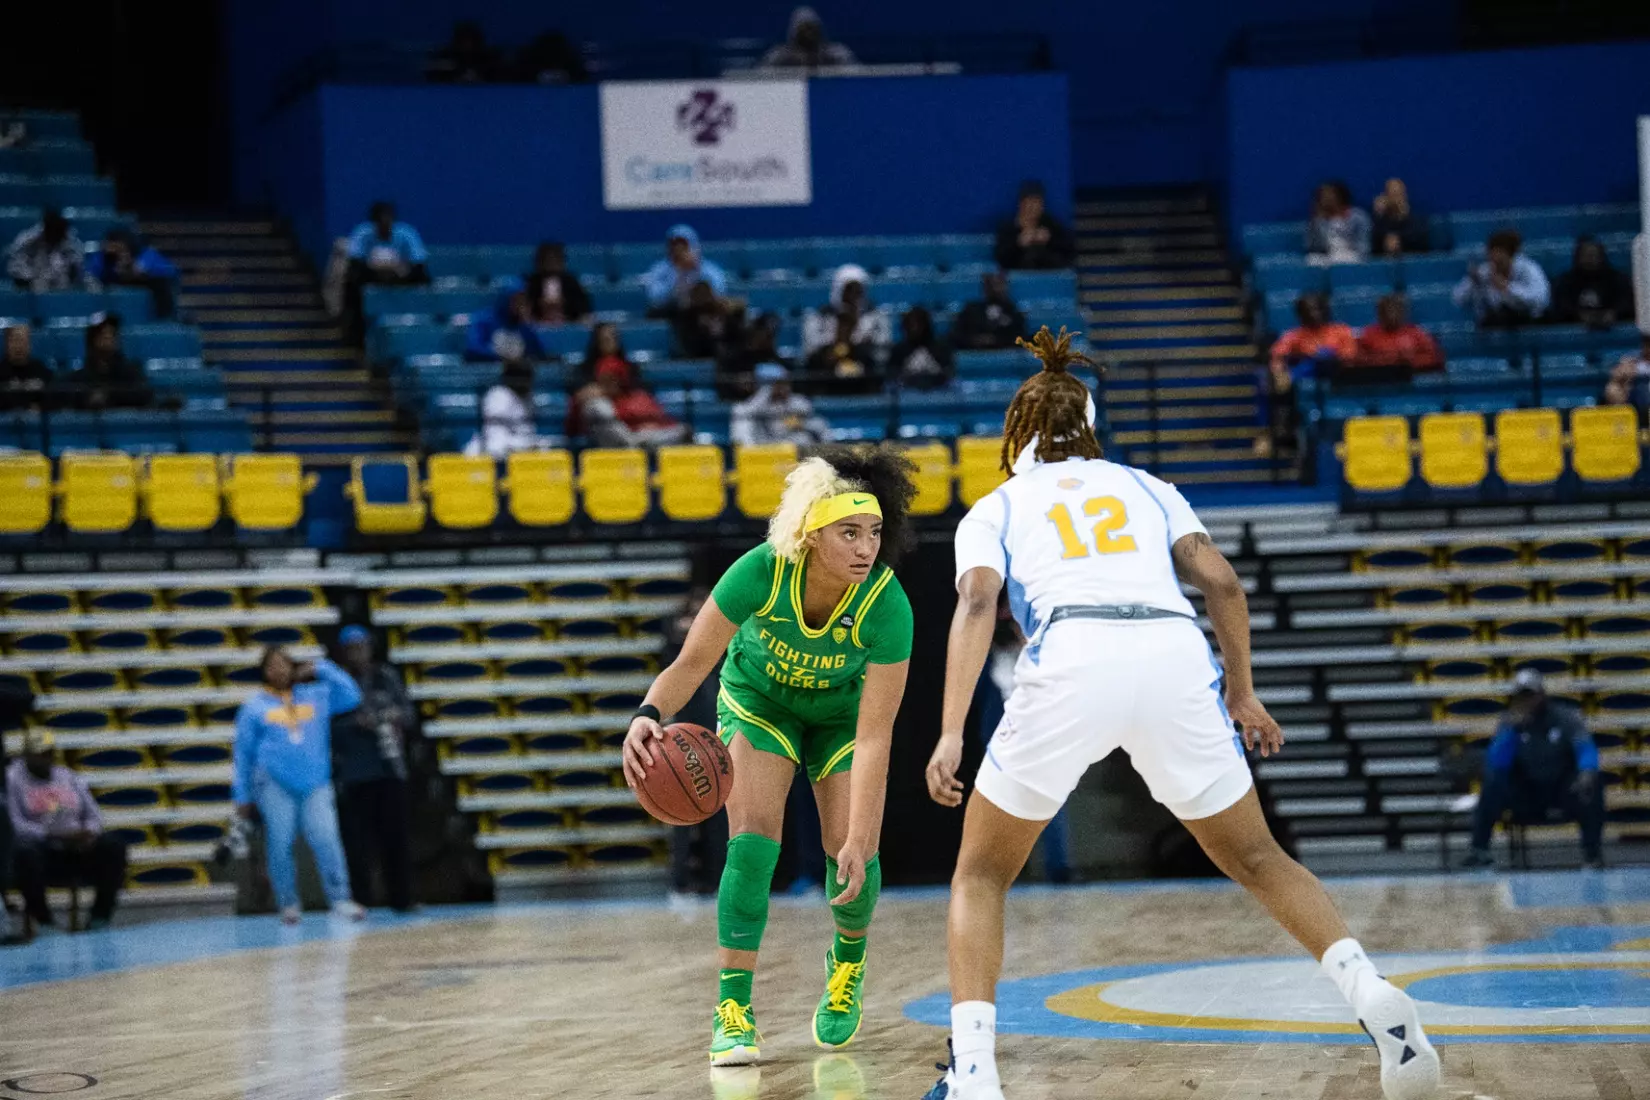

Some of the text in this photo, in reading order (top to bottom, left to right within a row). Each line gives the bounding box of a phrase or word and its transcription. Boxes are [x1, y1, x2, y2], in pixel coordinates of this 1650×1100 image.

[1046, 495, 1138, 559] 12
[760, 628, 846, 669] FIGHTING
[765, 661, 830, 689] DUCKS
[672, 733, 712, 799] Wilson
